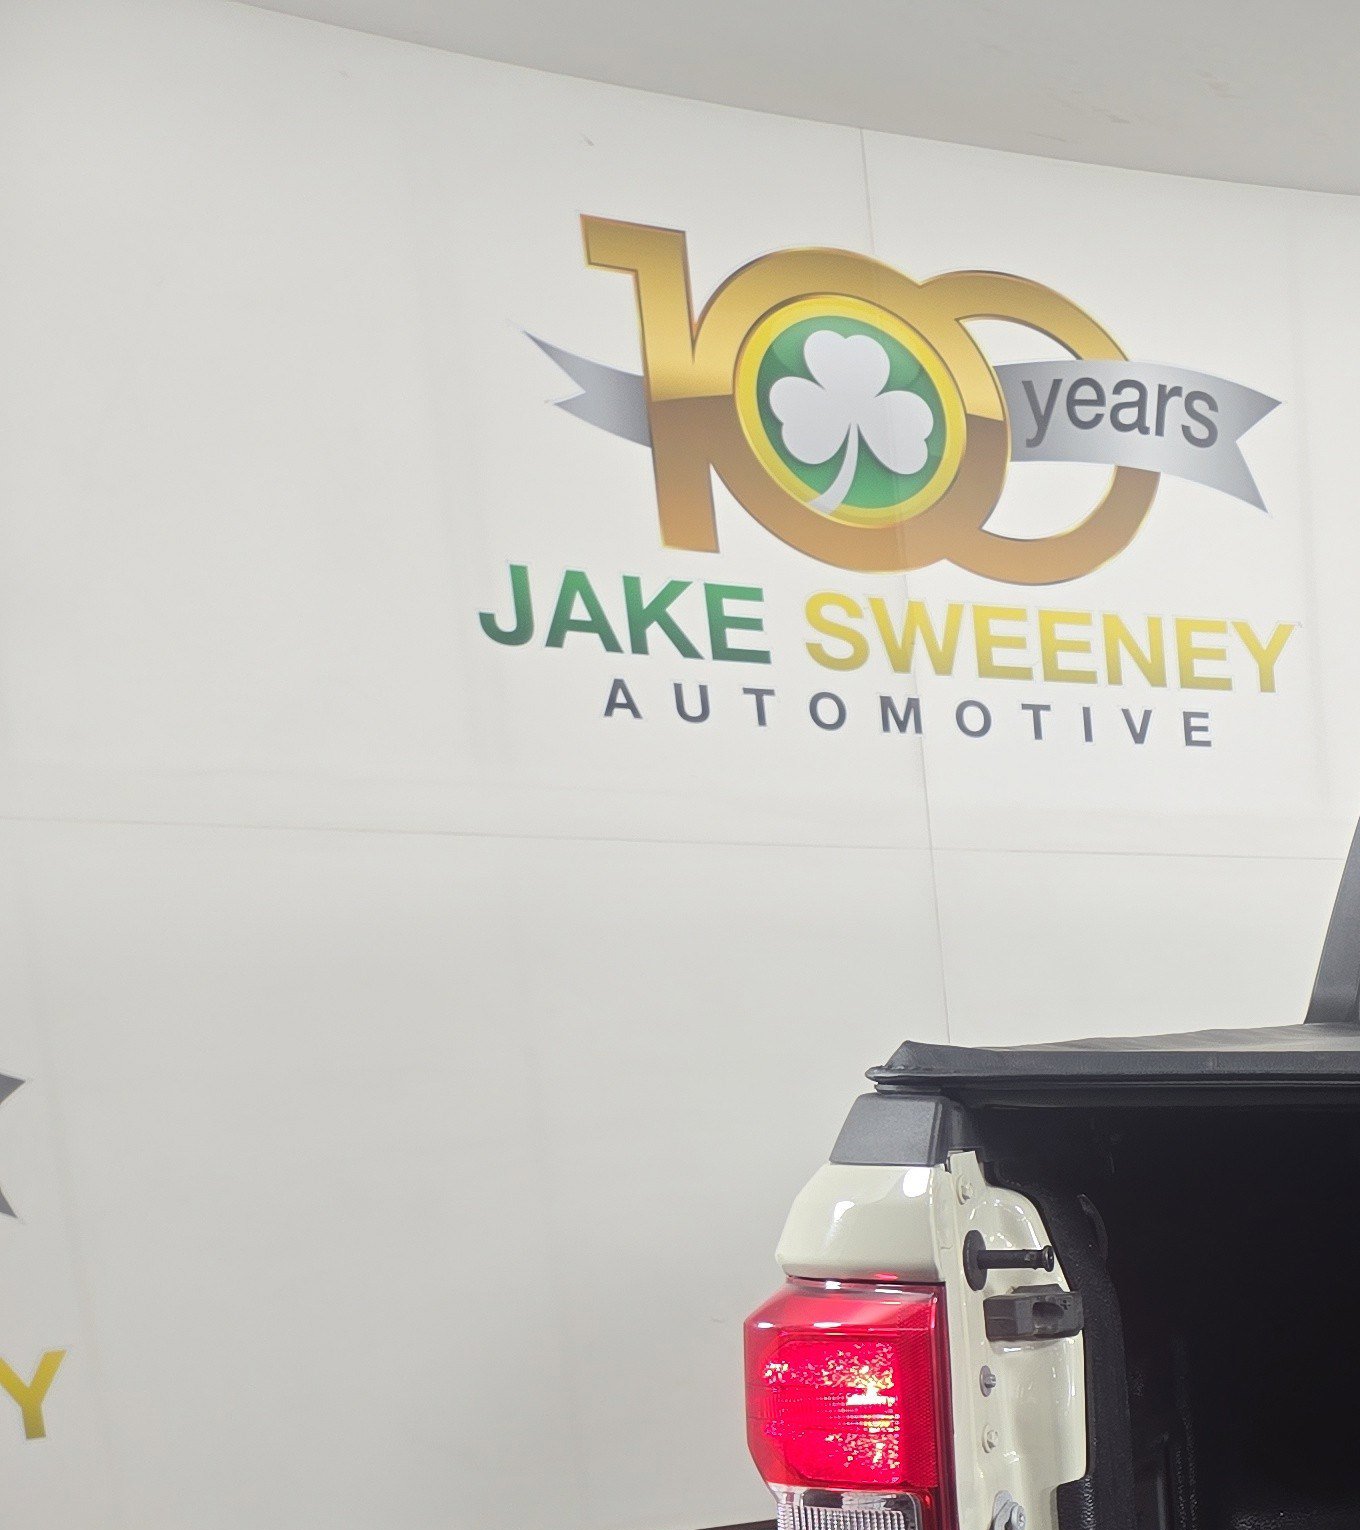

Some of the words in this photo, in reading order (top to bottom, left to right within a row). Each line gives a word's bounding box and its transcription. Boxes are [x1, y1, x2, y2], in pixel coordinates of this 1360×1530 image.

[1021, 372, 1220, 449] years
[477, 562, 772, 664] JAKE
[804, 591, 1297, 693] SWEENEY
[603, 677, 1214, 748] AUTOMOTIVE
